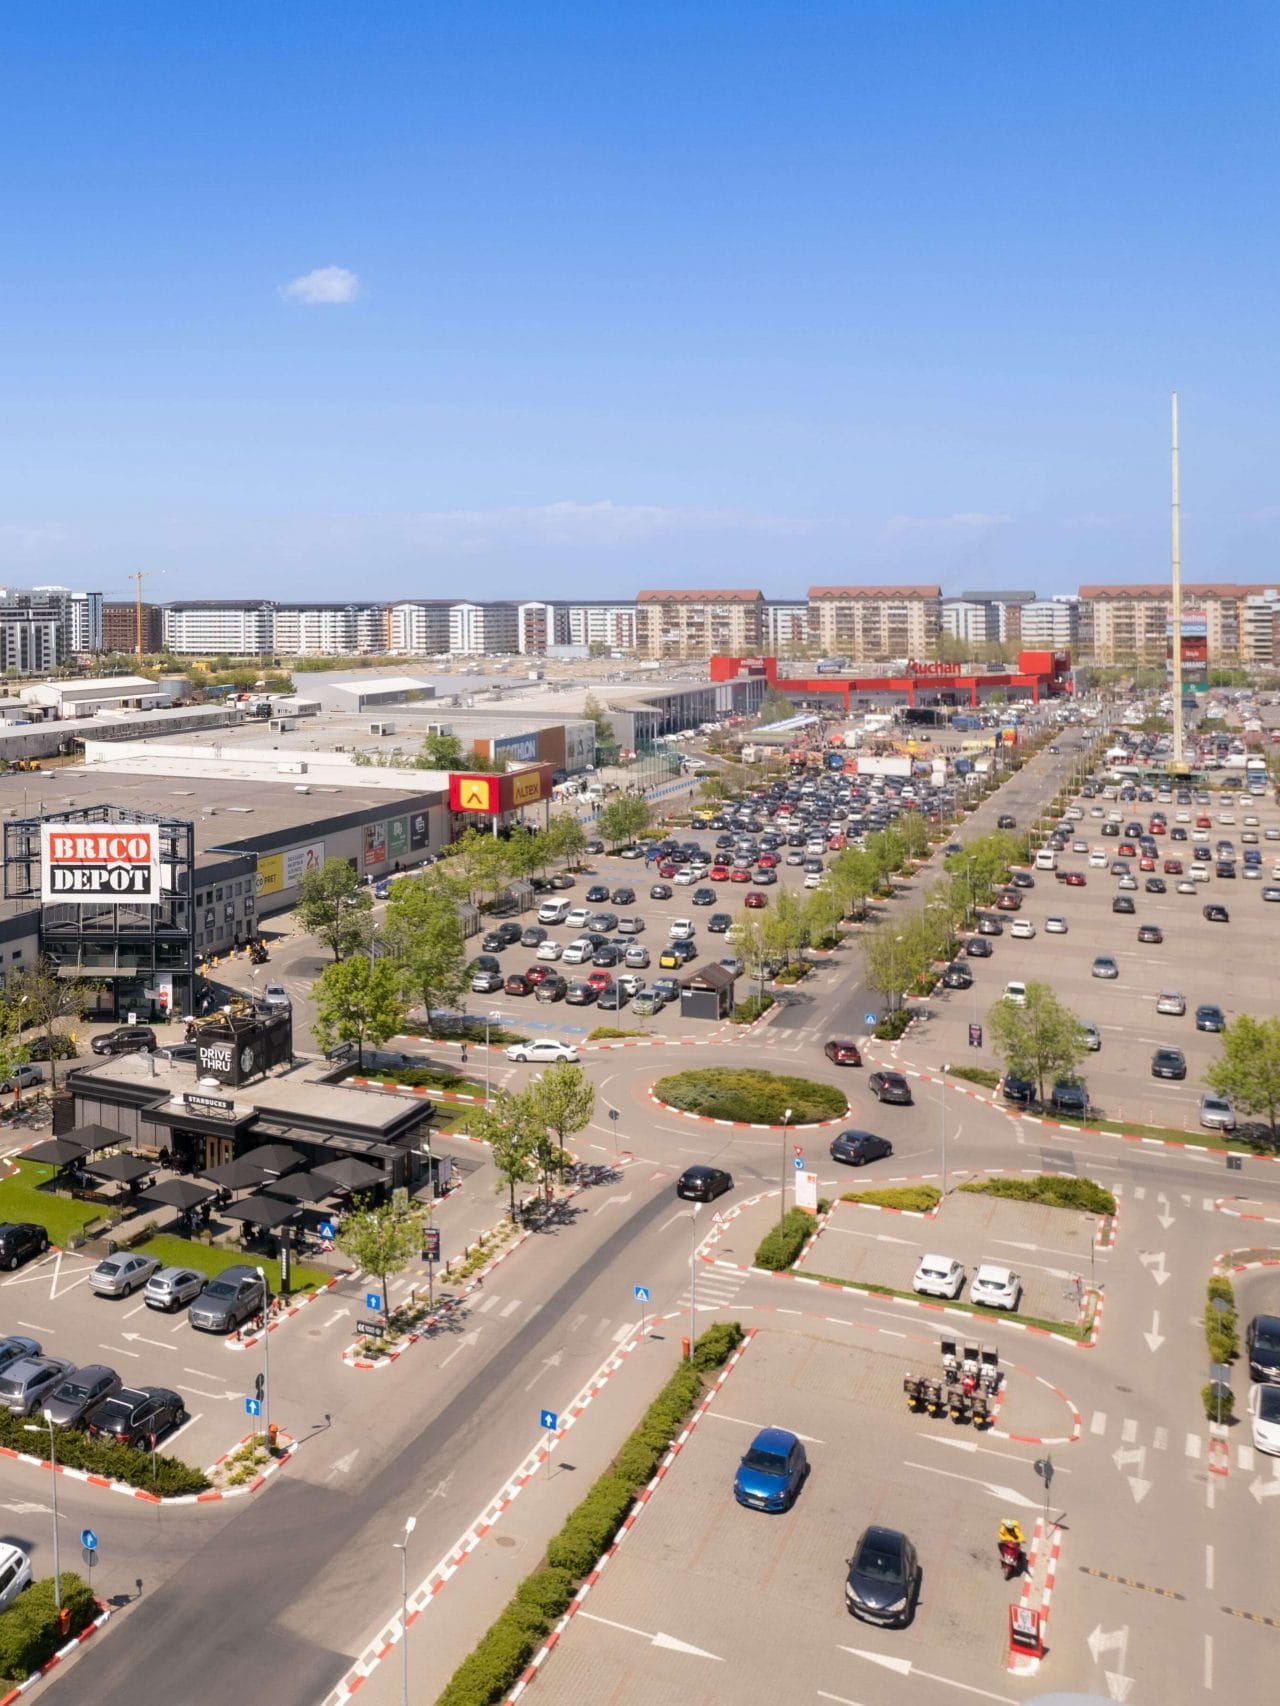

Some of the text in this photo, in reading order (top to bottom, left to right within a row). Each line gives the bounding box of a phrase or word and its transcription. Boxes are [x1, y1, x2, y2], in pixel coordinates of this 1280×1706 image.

[54, 838, 148, 859] BRICO
[200, 1047, 232, 1062] DRIVE
[201, 1057, 231, 1072] THRU
[188, 1096, 227, 1108] STARBUCKS
